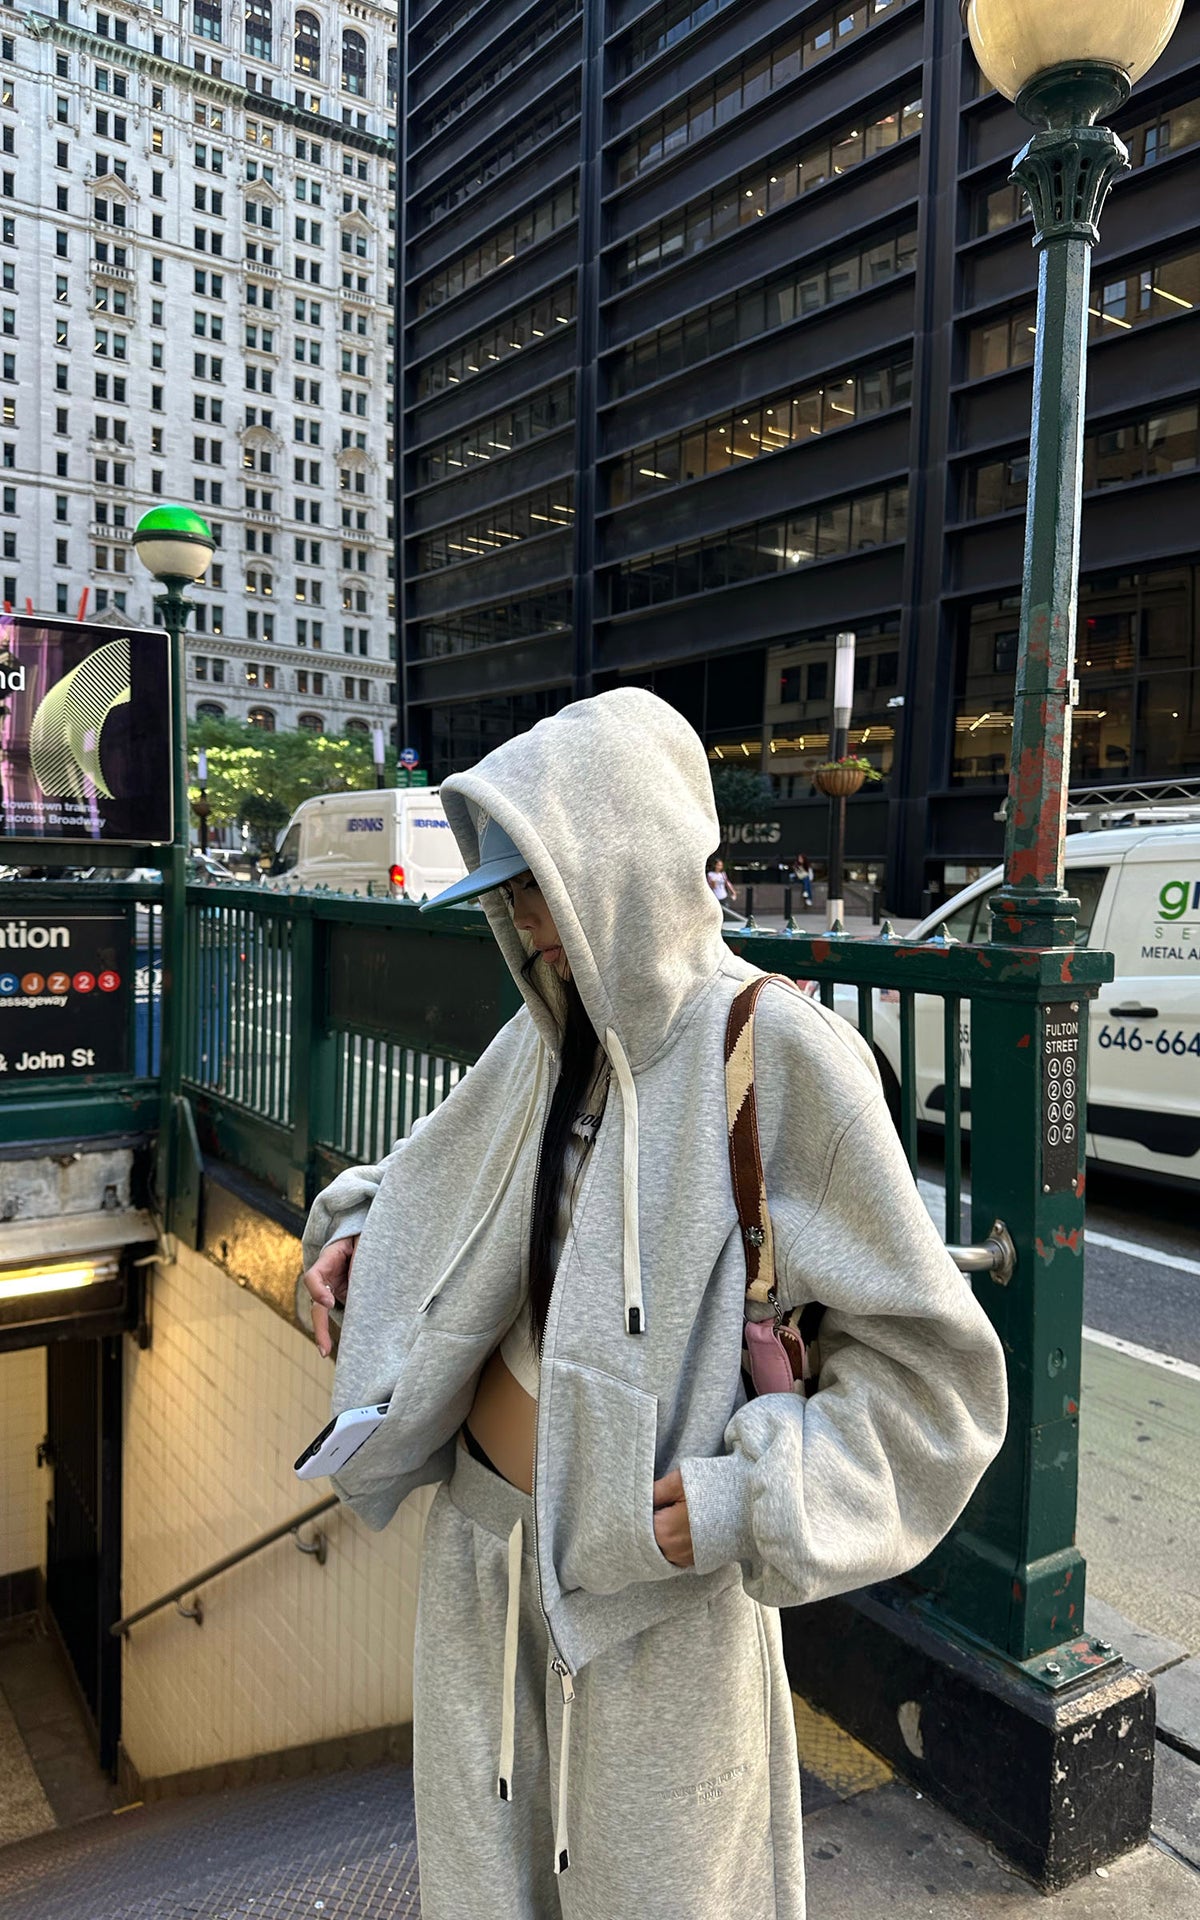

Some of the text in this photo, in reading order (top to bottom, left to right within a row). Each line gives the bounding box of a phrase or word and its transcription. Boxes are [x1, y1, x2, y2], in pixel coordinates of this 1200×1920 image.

[1, 800, 100, 814] downtown trains,
[6, 814, 46, 824] across
[48, 814, 106, 828] Broadway
[1141, 946, 1200, 960] METAL A
[1045, 1022, 1079, 1037] FULTON
[1045, 1039, 1079, 1054] STREET
[1098, 1024, 1200, 1057] 646-664
[15, 1050, 65, 1071] John
[71, 1047, 96, 1068] St
